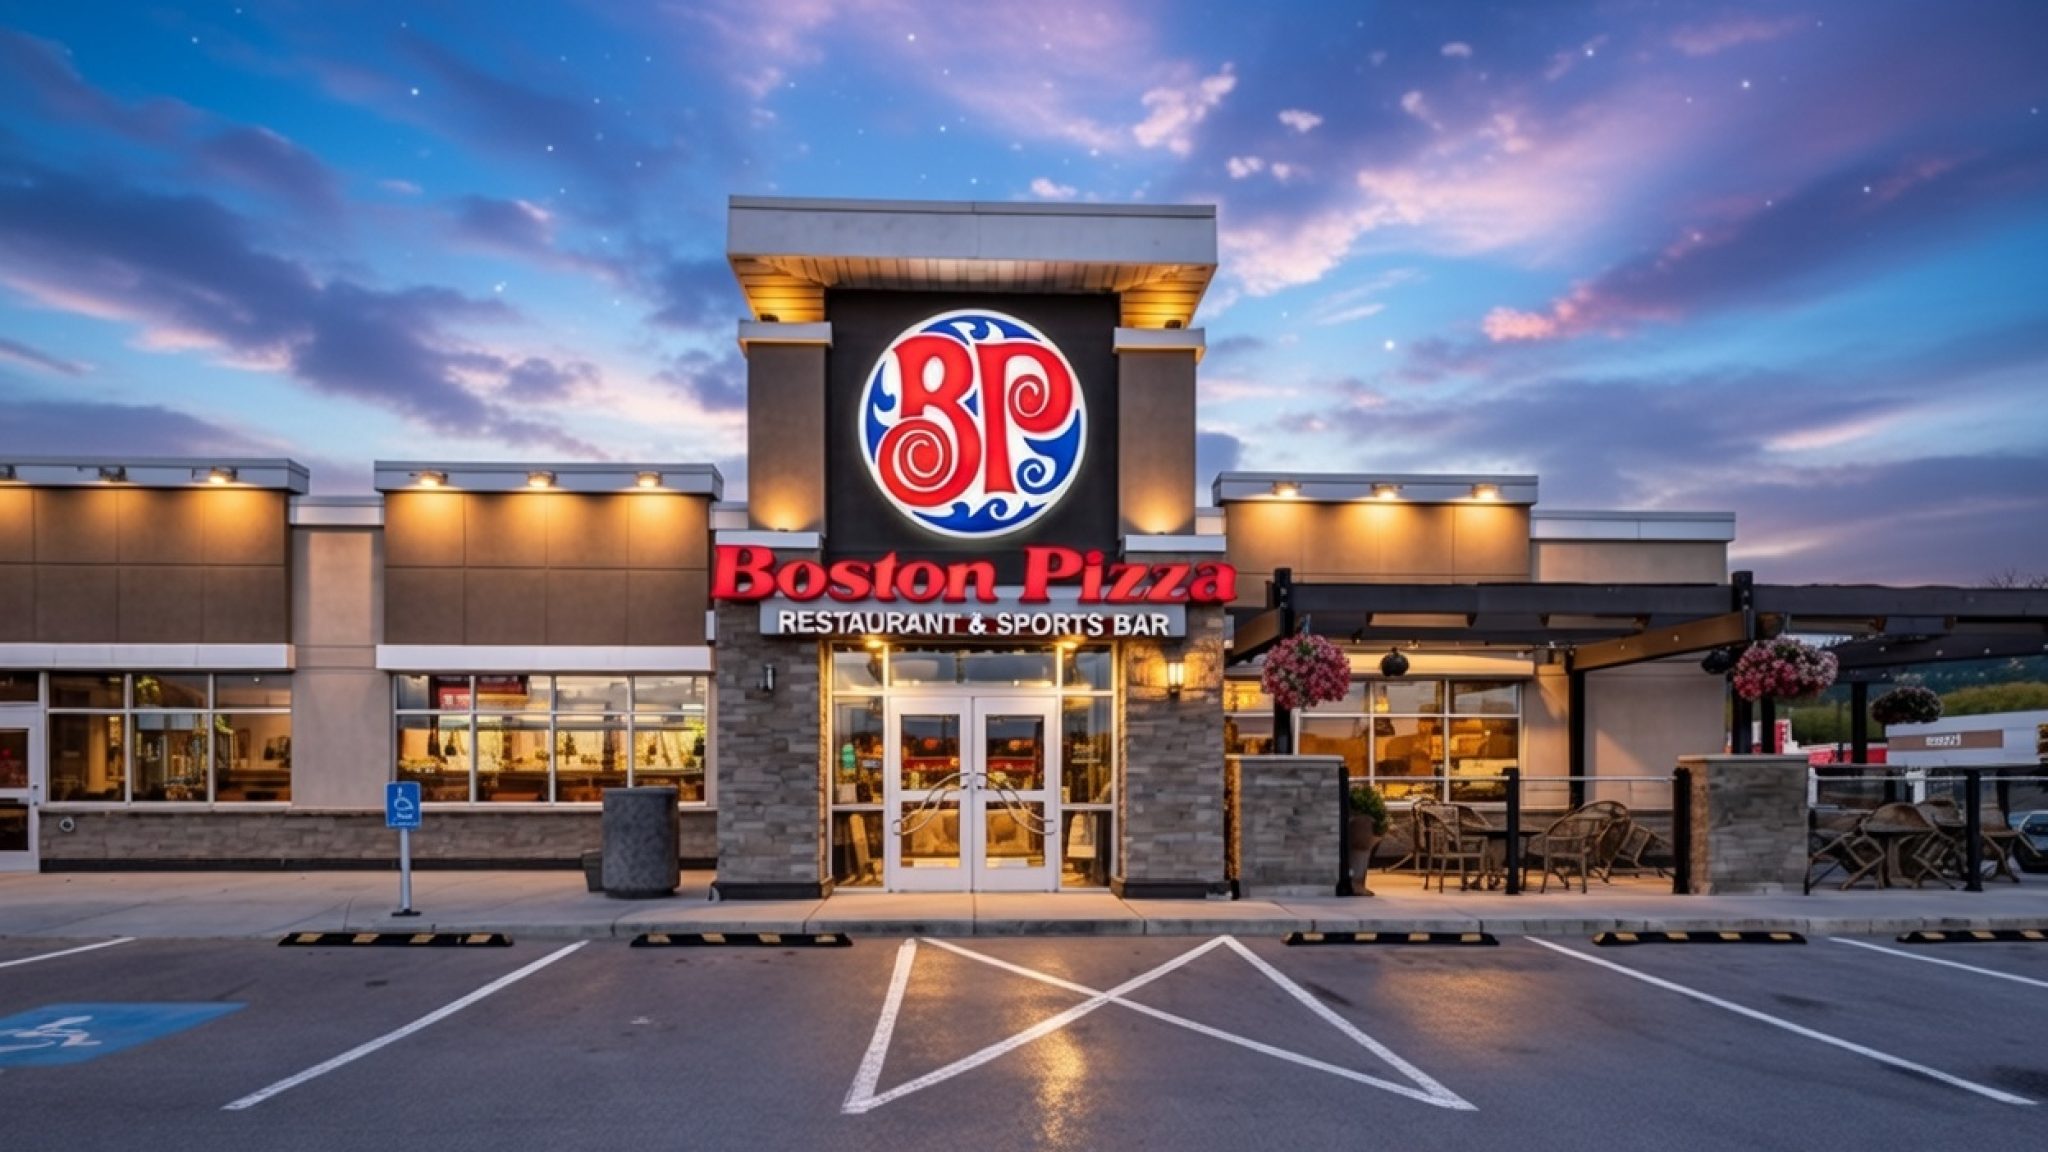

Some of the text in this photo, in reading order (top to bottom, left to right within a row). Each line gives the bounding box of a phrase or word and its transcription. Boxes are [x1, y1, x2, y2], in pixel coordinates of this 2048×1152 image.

[876, 334, 1073, 508] BP
[711, 544, 1237, 604] Boston Pizza
[778, 610, 1169, 635] RESTAURANT & SPORTS BAR
